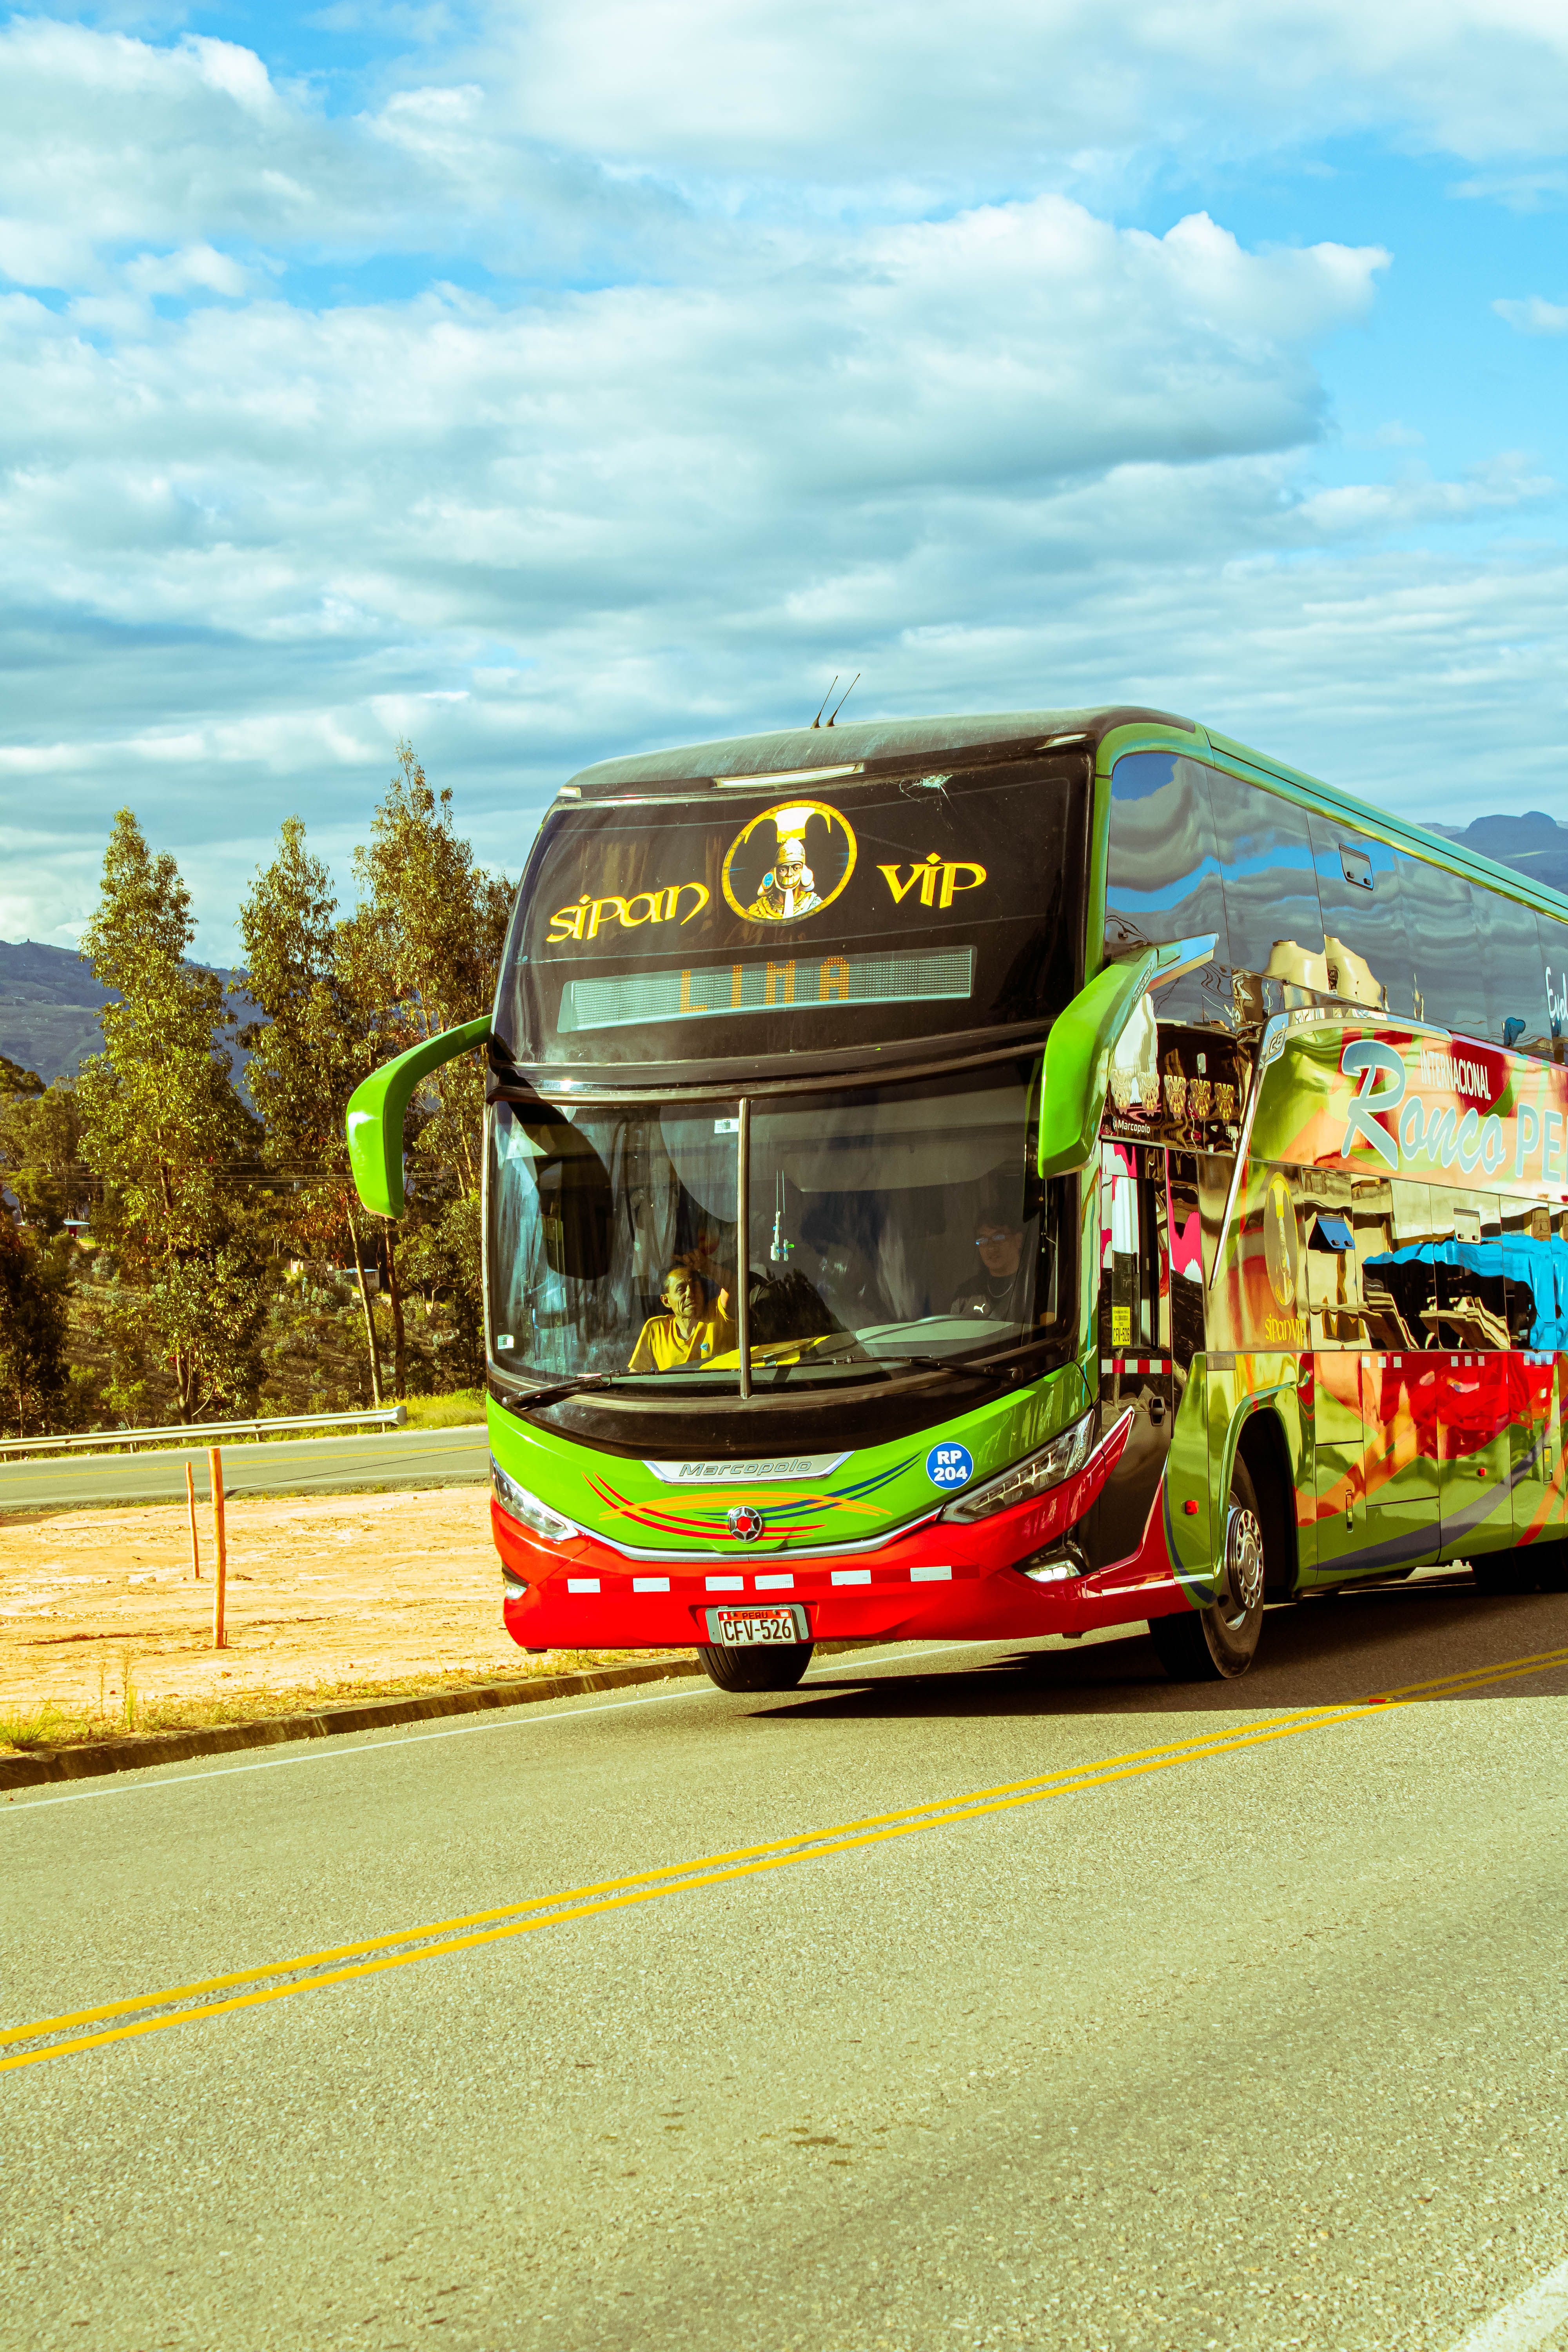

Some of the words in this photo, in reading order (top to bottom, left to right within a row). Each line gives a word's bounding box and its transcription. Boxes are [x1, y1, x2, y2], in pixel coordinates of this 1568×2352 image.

[680, 956, 849, 1013] LIMA
[1420, 1049, 1491, 1100] INTERNACIONAL
[1341, 1039, 1506, 1175] Ronco
[1515, 1102, 1568, 1185] PE
[1118, 1119, 1150, 1134] Marcopolo
[1113, 1327, 1130, 1342] CFV-526
[937, 1450, 962, 1465] RP
[679, 1458, 812, 1477] Marcopolo
[933, 1466, 968, 1481] 204
[742, 1611, 768, 1619] PERU
[724, 1619, 792, 1641] CFV-526
